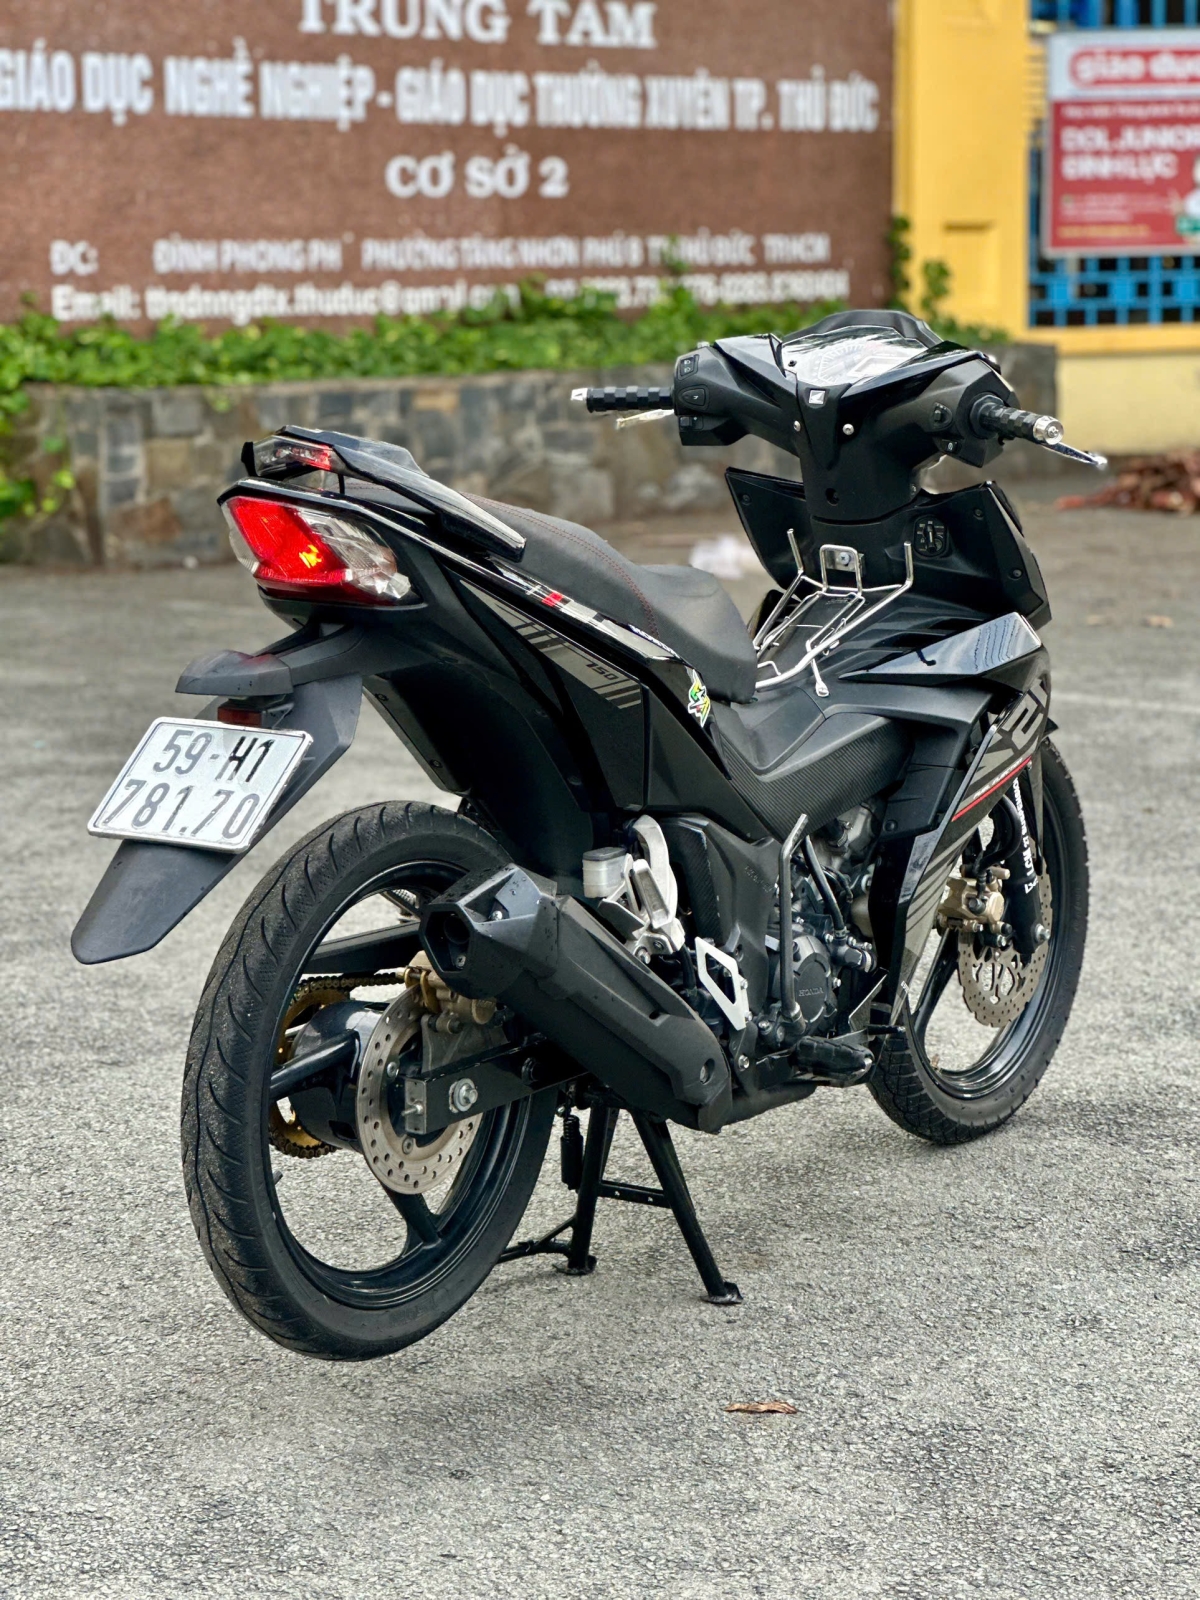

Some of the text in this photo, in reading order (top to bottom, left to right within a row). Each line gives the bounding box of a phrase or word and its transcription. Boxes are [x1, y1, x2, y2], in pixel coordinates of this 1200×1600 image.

[299, 0, 510, 42] TRUNG
[0, 38, 76, 112] GIÁO
[81, 50, 154, 127] DỤC
[395, 57, 467, 125] GIÁO
[469, 69, 531, 138] DỤC
[385, 144, 570, 199] CƠ SỞ 2
[152, 729, 276, 783] 59-H1
[102, 778, 260, 839] 781.70
